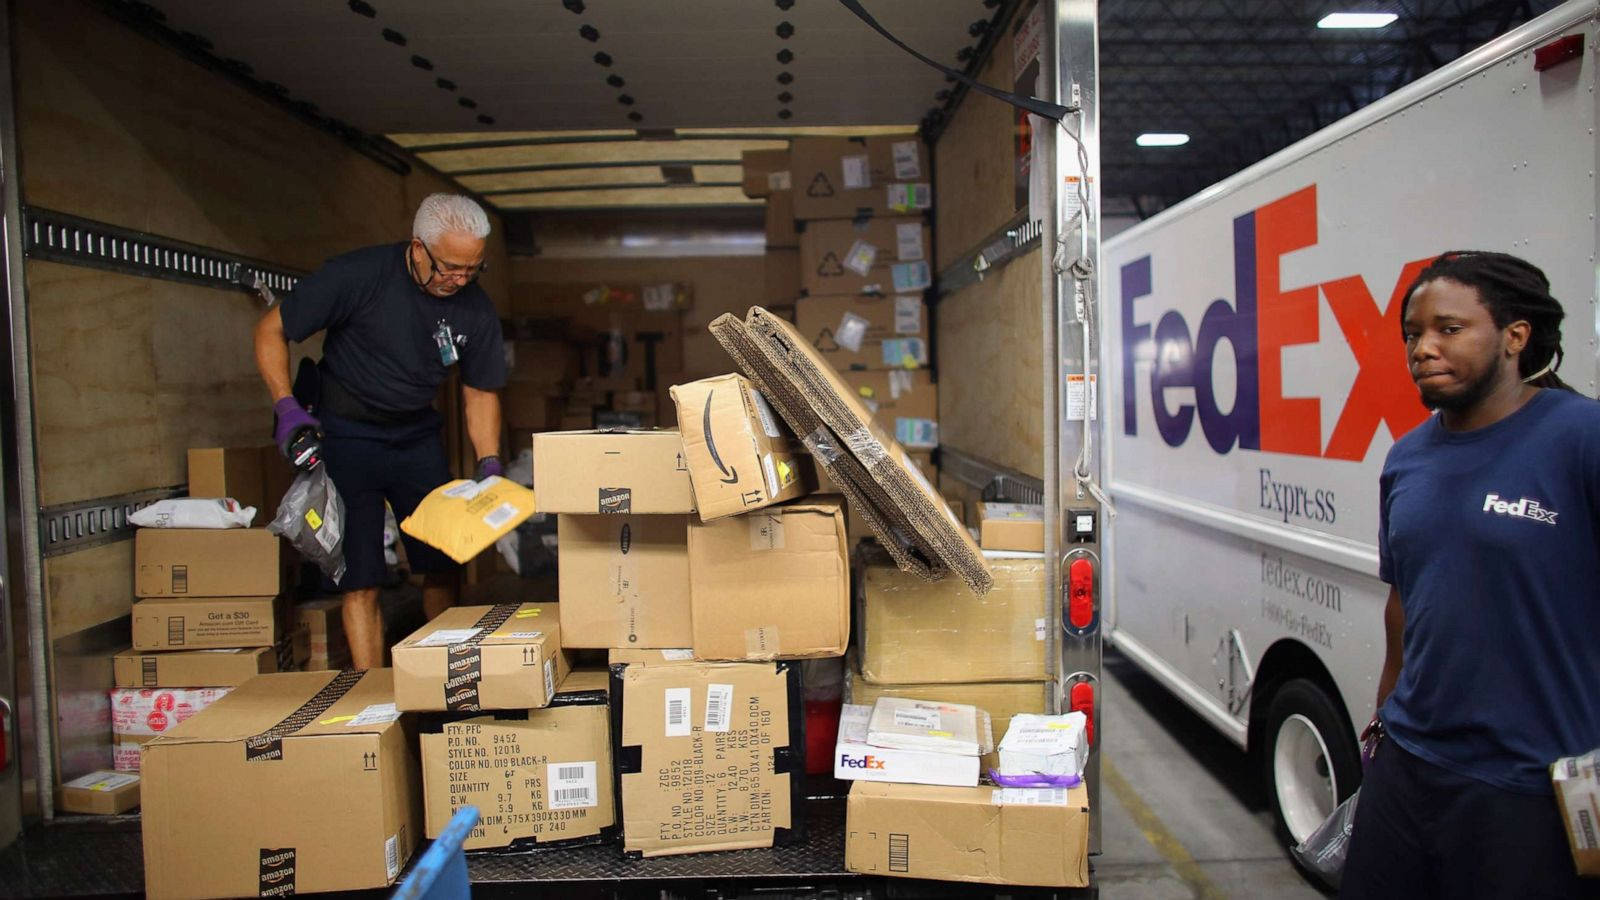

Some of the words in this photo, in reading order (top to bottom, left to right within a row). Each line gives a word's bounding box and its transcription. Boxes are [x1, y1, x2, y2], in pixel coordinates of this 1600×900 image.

[1121, 183, 1458, 462] FedEx
[600, 493, 630, 506] amazon
[1259, 468, 1336, 524] Express
[1482, 494, 1558, 524] FedEx
[1260, 554, 1342, 612] fedex.com
[208, 612, 223, 620] Get
[233, 611, 249, 620] $30
[450, 655, 480, 670] amazon
[761, 710, 770, 726] 160
[466, 724, 481, 734] PFC
[466, 737, 480, 746] NO.
[494, 734, 516, 744] 9452
[716, 731, 725, 760] PAIRS
[727, 730, 736, 748] KGS
[738, 730, 748, 748] KGS
[761, 733, 770, 744] OF
[449, 748, 473, 758] STYLE
[475, 748, 488, 757] NO.
[494, 745, 520, 755] 12018
[449, 760, 475, 770] COLOR
[478, 760, 492, 769] NO.
[494, 759, 508, 768] 019
[510, 756, 547, 767] BLACK-R
[841, 754, 886, 769] FedEx
[449, 772, 468, 781] SIZE
[728, 765, 738, 791] 12.40
[739, 769, 749, 791] 8.70
[450, 782, 490, 793] QUANTITY
[507, 781, 512, 790] 6
[525, 778, 541, 788] PRS
[498, 794, 512, 802] 9.7
[531, 790, 541, 799] KG
[499, 804, 513, 813] 5.9
[532, 802, 542, 810] KG
[672, 805, 681, 816] NO
[534, 824, 543, 833] OF
[550, 822, 566, 831] 240
[683, 808, 693, 838] STYLE
[694, 805, 705, 836] COLOR
[706, 814, 716, 836] SIZE
[751, 812, 760, 831] CTN
[660, 822, 670, 840] FTY
[262, 851, 294, 866] amazon
[261, 868, 294, 881] amazon
[261, 883, 294, 896] amazon
